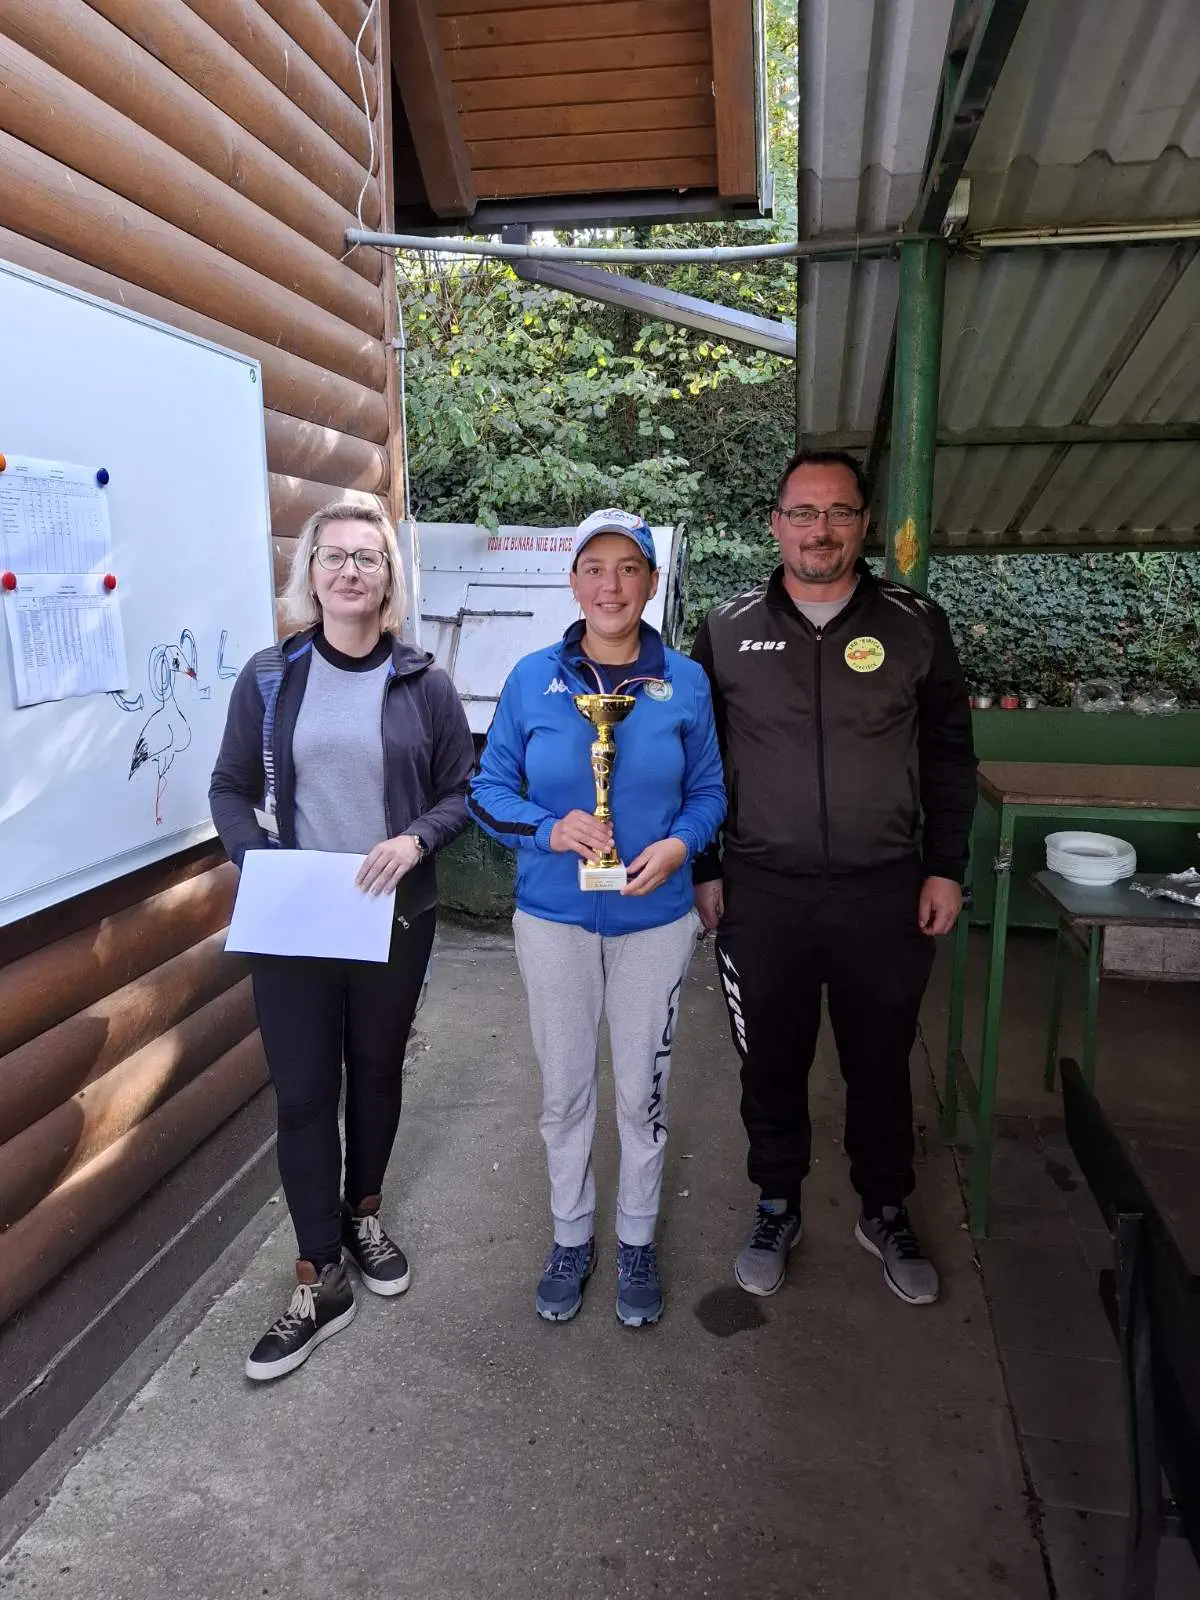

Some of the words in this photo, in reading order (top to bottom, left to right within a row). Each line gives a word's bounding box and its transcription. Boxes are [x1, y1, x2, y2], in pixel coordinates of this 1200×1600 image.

[502, 536, 509, 551] IZ
[510, 536, 534, 551] BUNARA
[549, 537, 557, 552] ZA
[738, 639, 787, 652] Zeus
